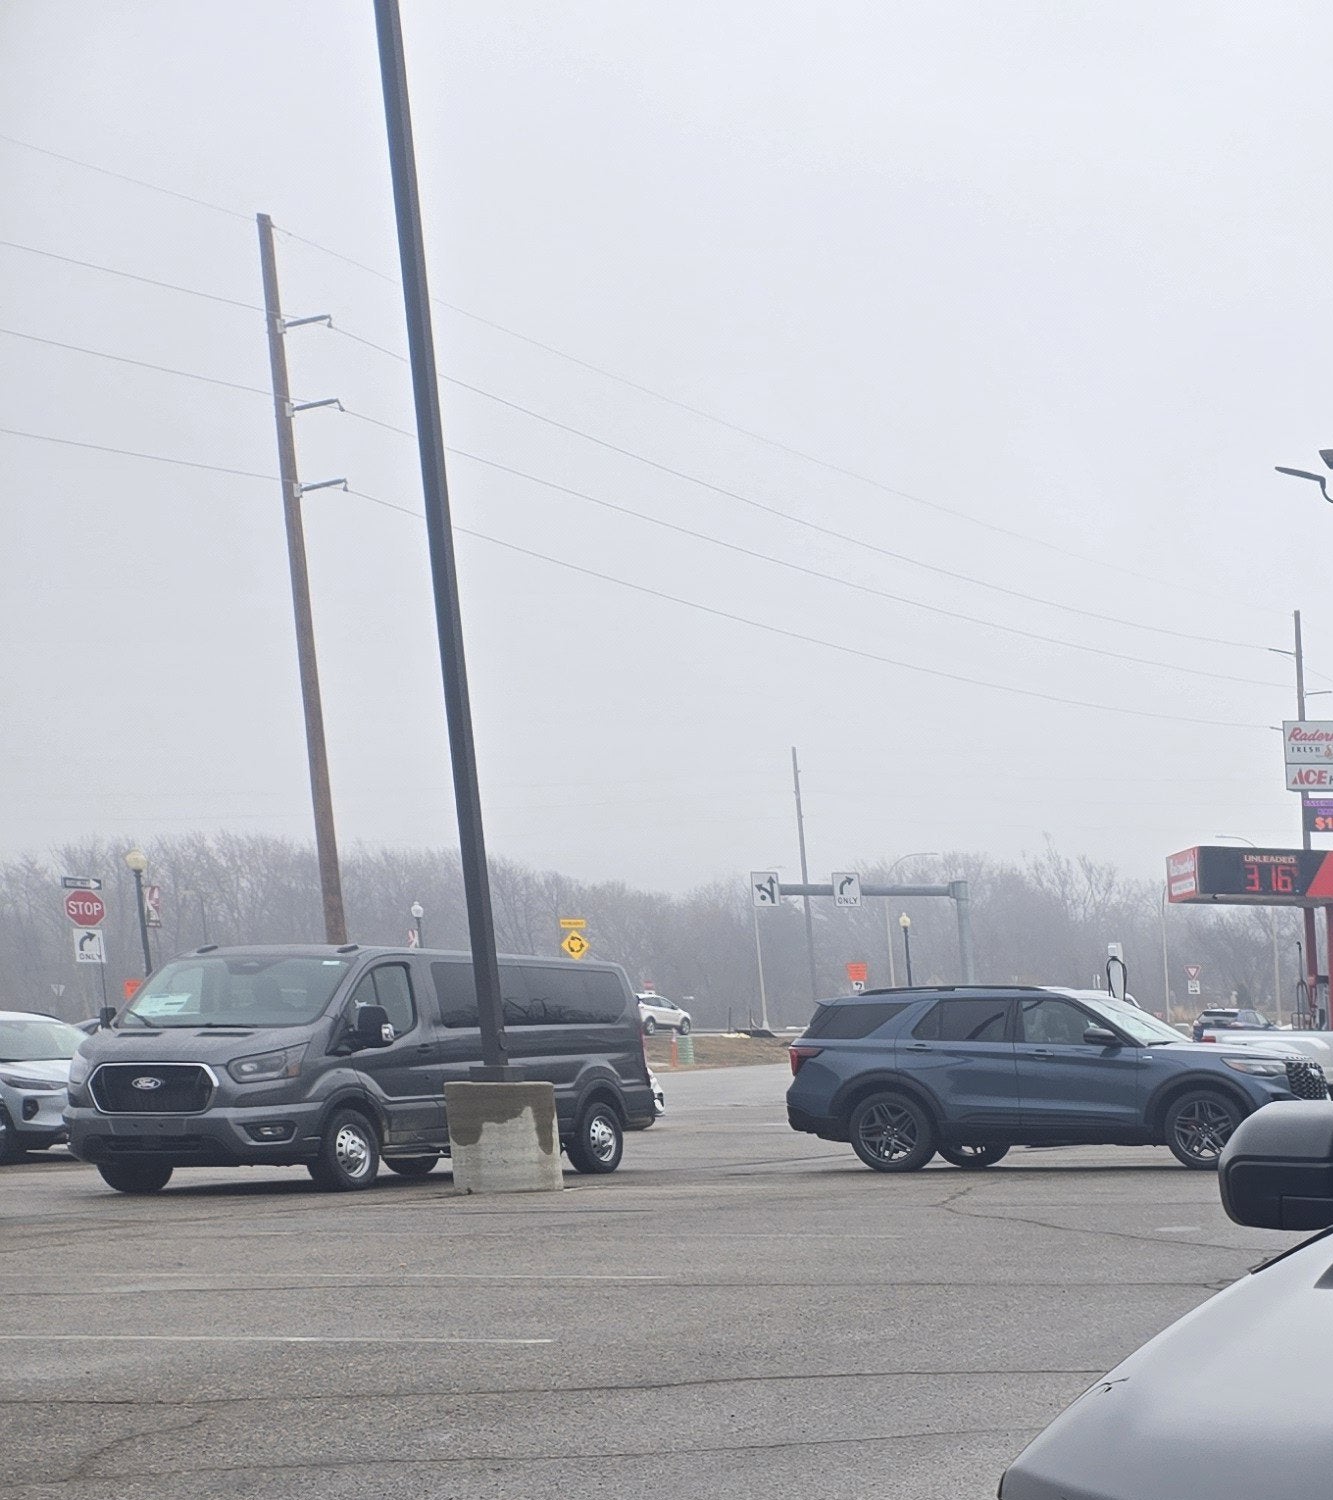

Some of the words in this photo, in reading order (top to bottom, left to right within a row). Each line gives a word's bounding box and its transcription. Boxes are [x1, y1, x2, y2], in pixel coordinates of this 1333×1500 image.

[1291, 768, 1328, 785] ACE
[1244, 855, 1296, 864] UNLEADED
[838, 896, 858, 905] ONLY
[68, 901, 102, 916] STOP
[79, 952, 102, 961] ONLY
